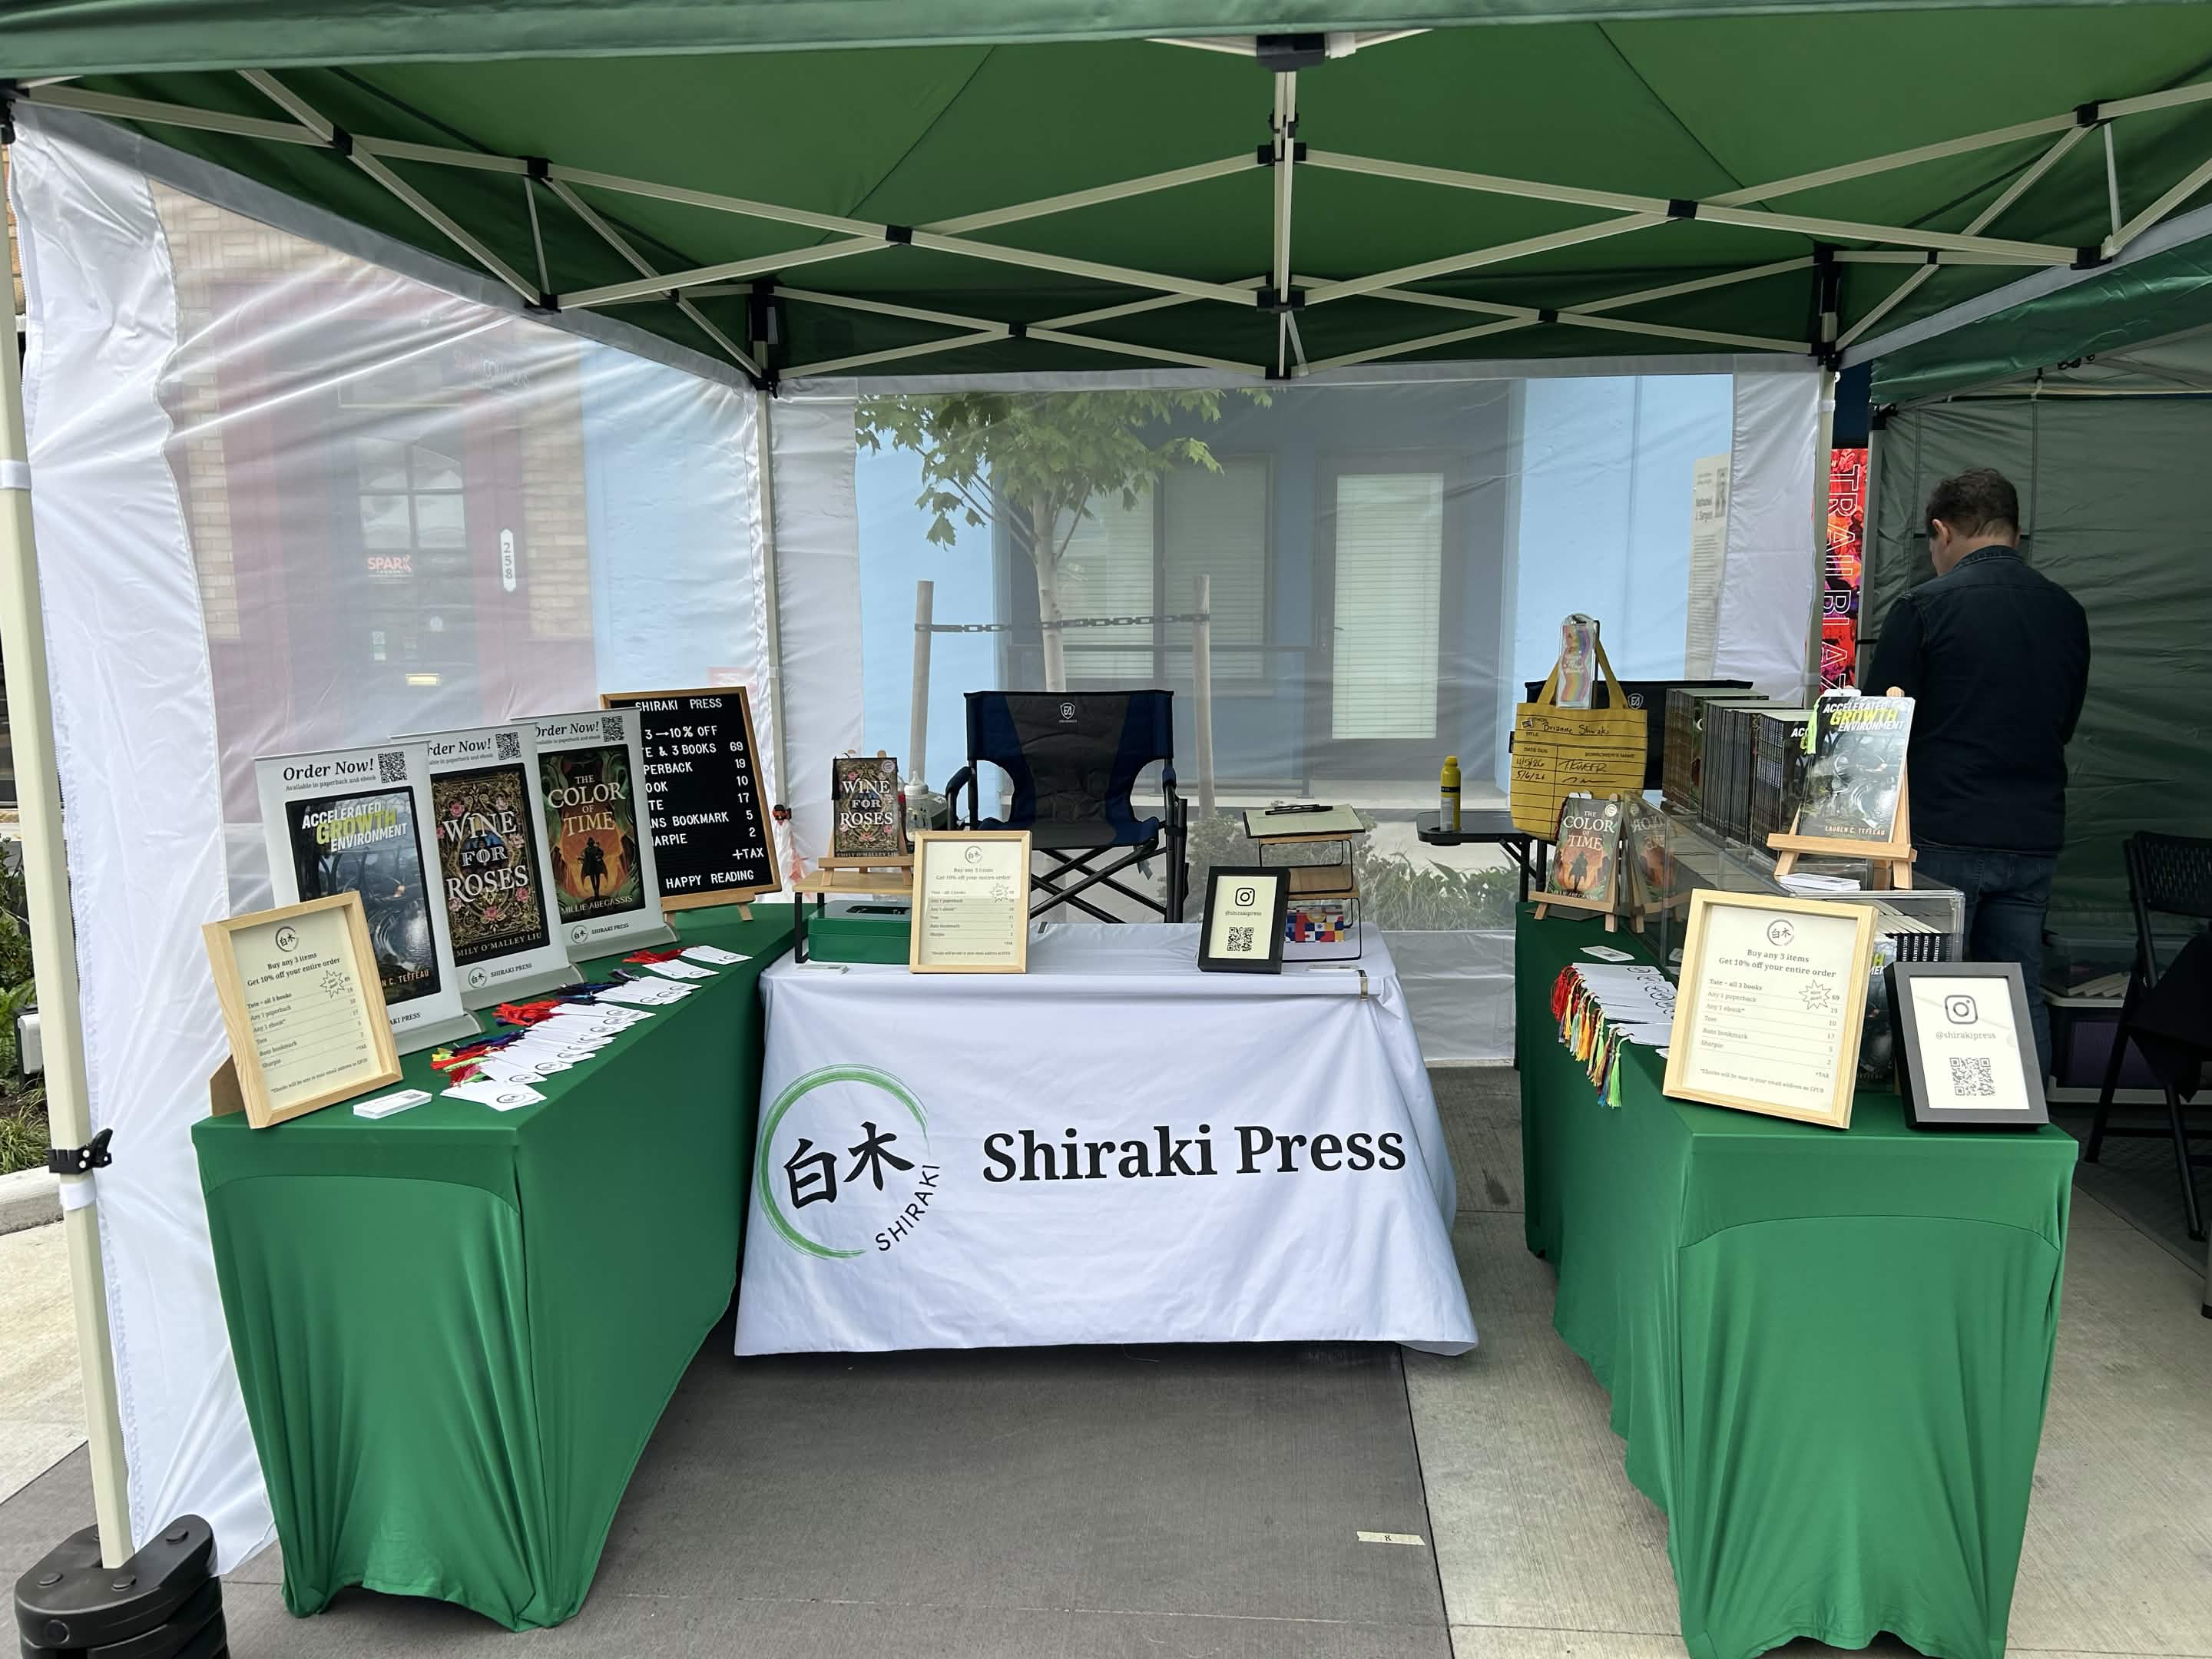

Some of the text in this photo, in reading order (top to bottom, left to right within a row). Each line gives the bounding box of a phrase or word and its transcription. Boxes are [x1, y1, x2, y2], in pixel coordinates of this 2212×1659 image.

[369, 554, 412, 572] SPARK
[503, 542, 513, 579] 258
[635, 698, 723, 712] SHIRAKI PRESS
[1823, 701, 1888, 714] ACCELERATED
[1830, 708, 1899, 727] GROWTH
[1838, 720, 1906, 732] ENVIRONMENT
[569, 721, 599, 734] Now!
[644, 725, 717, 740] 3 10% OFF
[428, 737, 492, 757] rder Now!
[659, 746, 668, 757] &
[672, 745, 679, 756] 3
[682, 743, 717, 755] BOOKS
[730, 741, 743, 752] 69
[283, 758, 374, 781] Order Now!
[644, 759, 746, 775] PERBACK 19
[286, 782, 313, 792] Available
[320, 777, 349, 789] paperback
[360, 774, 376, 783] ebook
[575, 774, 595, 785] THE
[645, 775, 749, 793] OOK 10
[842, 778, 891, 795] WINE
[548, 782, 627, 809] COLOR
[648, 792, 750, 810] TE 17
[581, 804, 594, 814] OF
[852, 800, 882, 810] FOR
[301, 801, 382, 830] ACCELERATED
[563, 811, 615, 837] TIME
[672, 811, 730, 827] BOOKMARK
[746, 810, 753, 820] 5
[840, 811, 894, 829] ROSES
[316, 809, 398, 846] GROWTH
[442, 810, 517, 843] WINE
[1563, 816, 1616, 833] COLOR
[1825, 825, 1849, 833] LAUREN
[330, 823, 408, 853] ENVIRONMENT
[653, 827, 757, 847] ARPIE 2
[1568, 834, 1603, 851] TIME
[461, 846, 508, 867] FOR
[732, 847, 765, 860] +TAX
[445, 865, 528, 903] ROSES
[665, 869, 755, 889] HAPPY READING
[561, 894, 634, 916] MILLIE ABECASSIS
[591, 922, 631, 935] SHIRAKI PRESS
[1771, 927, 1791, 939] 白木
[279, 932, 296, 948] 白木
[481, 936, 525, 952] O'MALLEY
[527, 932, 542, 942] LIU
[267, 962, 280, 971] Buy
[281, 959, 293, 968] any
[300, 952, 318, 962] items
[1747, 949, 1762, 958] Buy
[1763, 952, 1778, 960] any
[1786, 954, 1810, 962] items
[247, 957, 341, 987] Get 10% off your entire order
[490, 962, 532, 978] SHIRAKI PRESS
[1719, 957, 1733, 965] Get
[1734, 959, 1750, 967] 10%
[1764, 964, 1784, 972] your
[1785, 965, 1810, 975] entire
[1812, 969, 1836, 978] order
[399, 969, 429, 984] TEFFEAU
[471, 972, 485, 984] 白木
[1743, 982, 1763, 991] books
[276, 992, 292, 1001] books
[1724, 993, 1757, 1002] paperback
[266, 1005, 292, 1018] paperback
[401, 1012, 422, 1023] PRESS
[1717, 1029, 1748, 1039] bookmark
[1936, 1030, 1997, 1041] @shirakipress
[1700, 1040, 1724, 1049] Sharpie
[982, 1124, 1407, 1184] Shiraki Press
[783, 1121, 916, 1210] 白木
[875, 1164, 941, 1252] SHIRAKI
